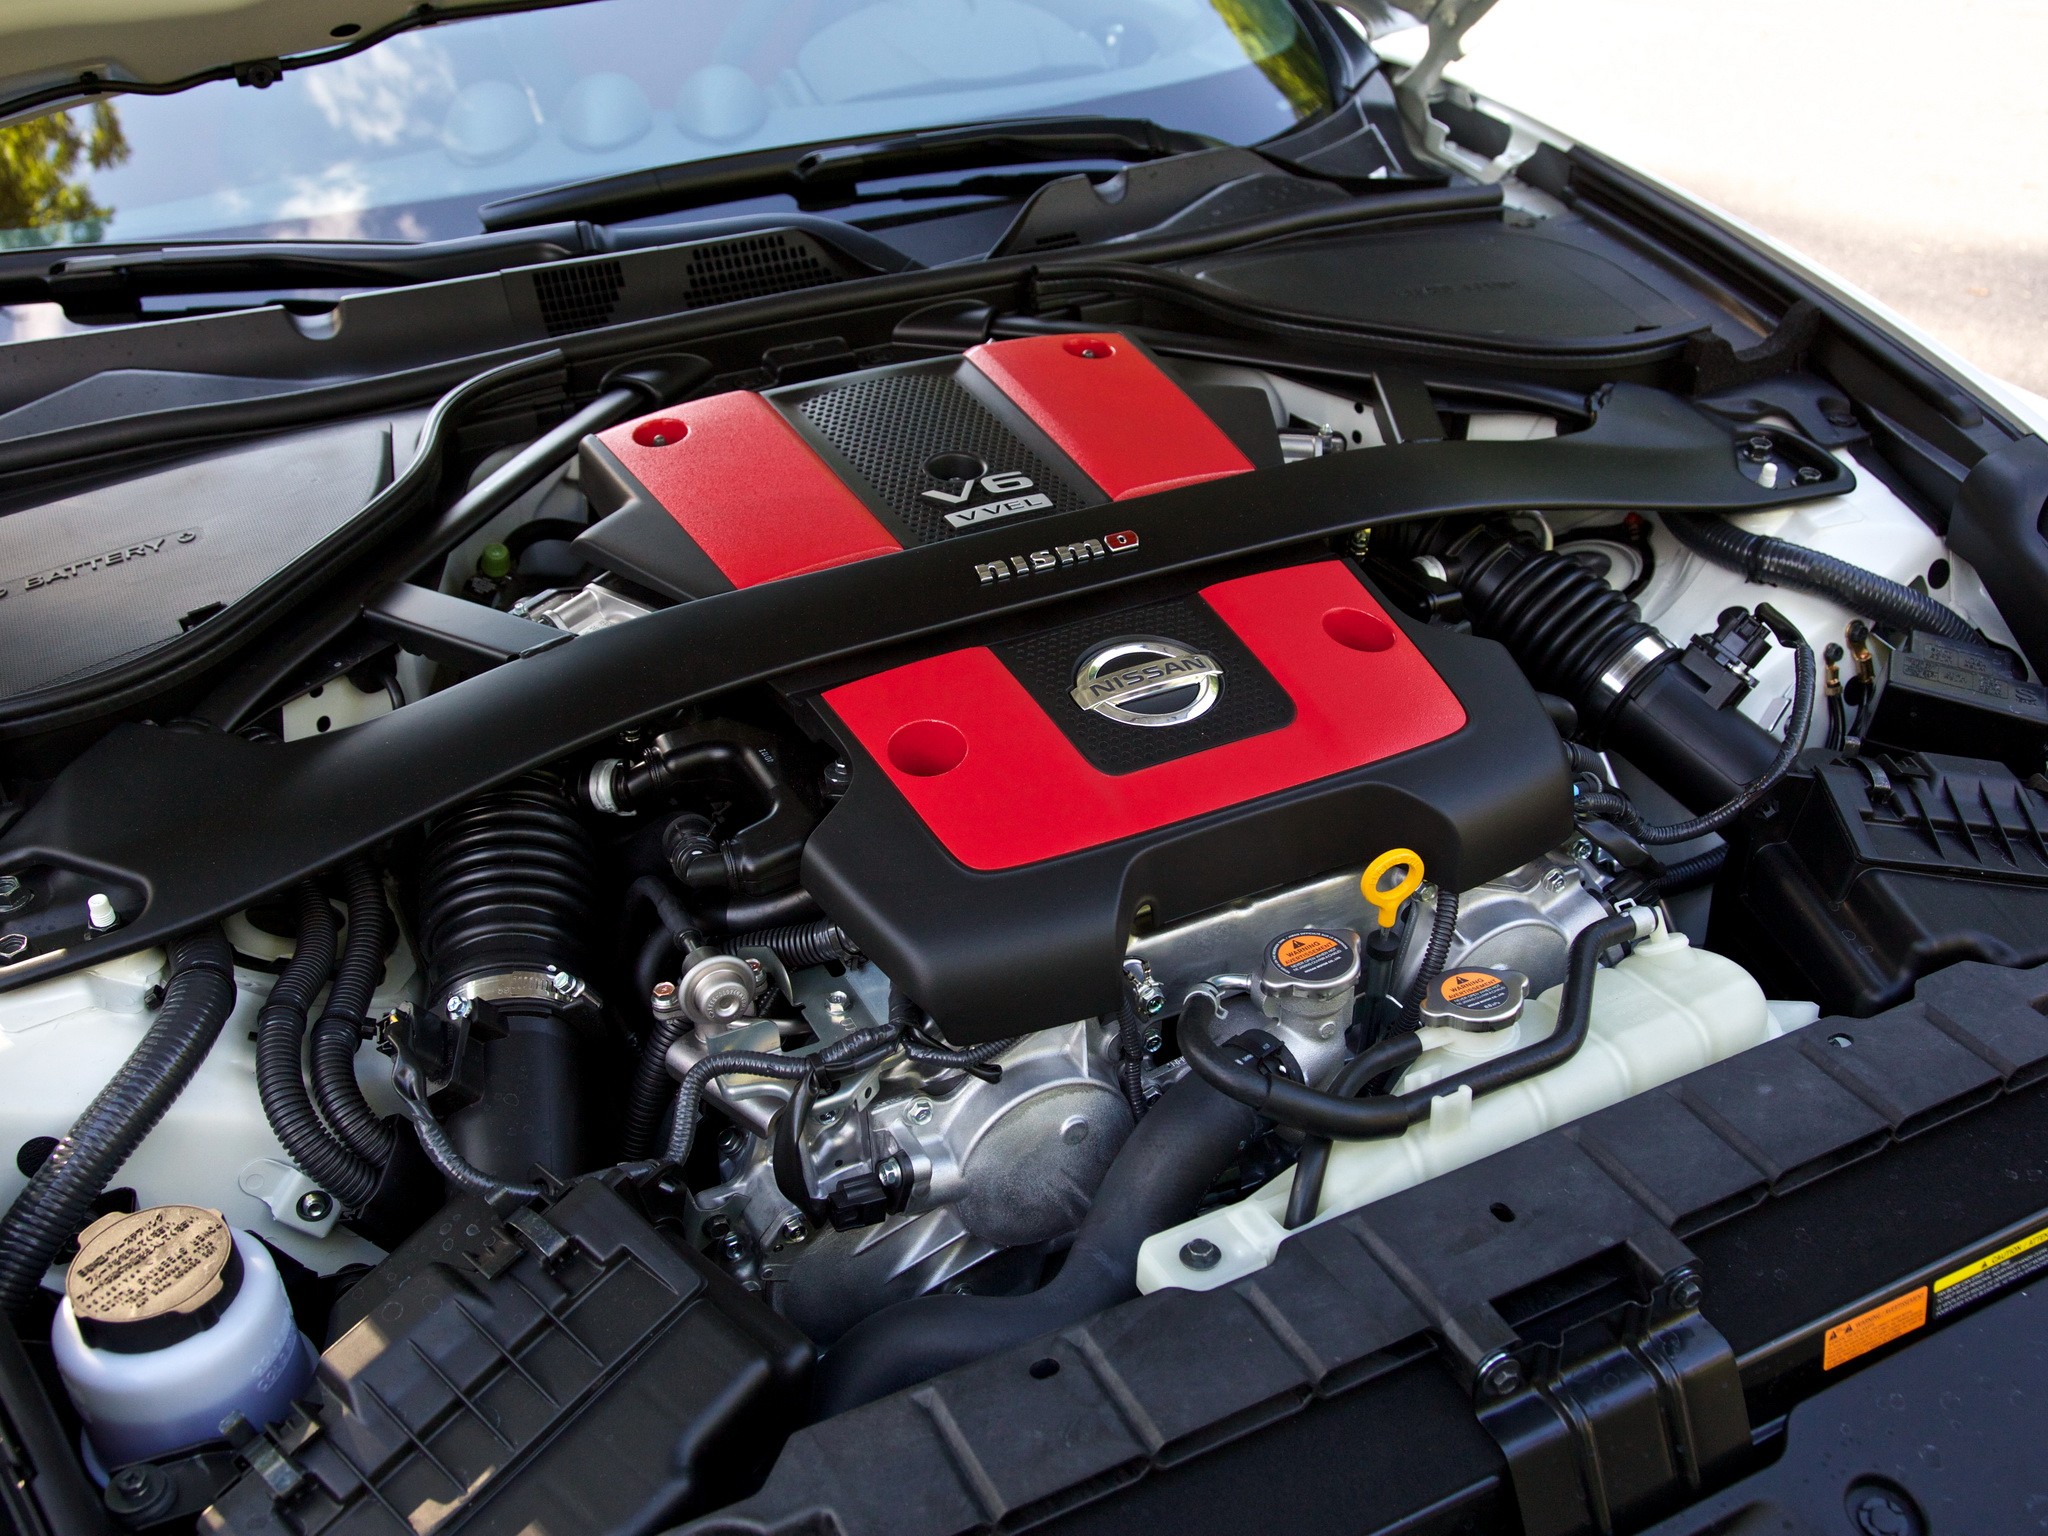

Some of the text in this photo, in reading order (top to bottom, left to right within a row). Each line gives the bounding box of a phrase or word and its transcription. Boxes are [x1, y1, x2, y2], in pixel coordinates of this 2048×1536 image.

[921, 471, 1034, 504] V6
[955, 498, 1043, 522] VVEL
[24, 538, 166, 591] BATTERY
[1089, 655, 1208, 697] NISSAN
[1285, 942, 1333, 964] AVERTISSEMENT
[1287, 941, 1320, 957] WARNING
[1448, 979, 1496, 999] AVERTISSEMENT
[1450, 978, 1484, 992] WARNING
